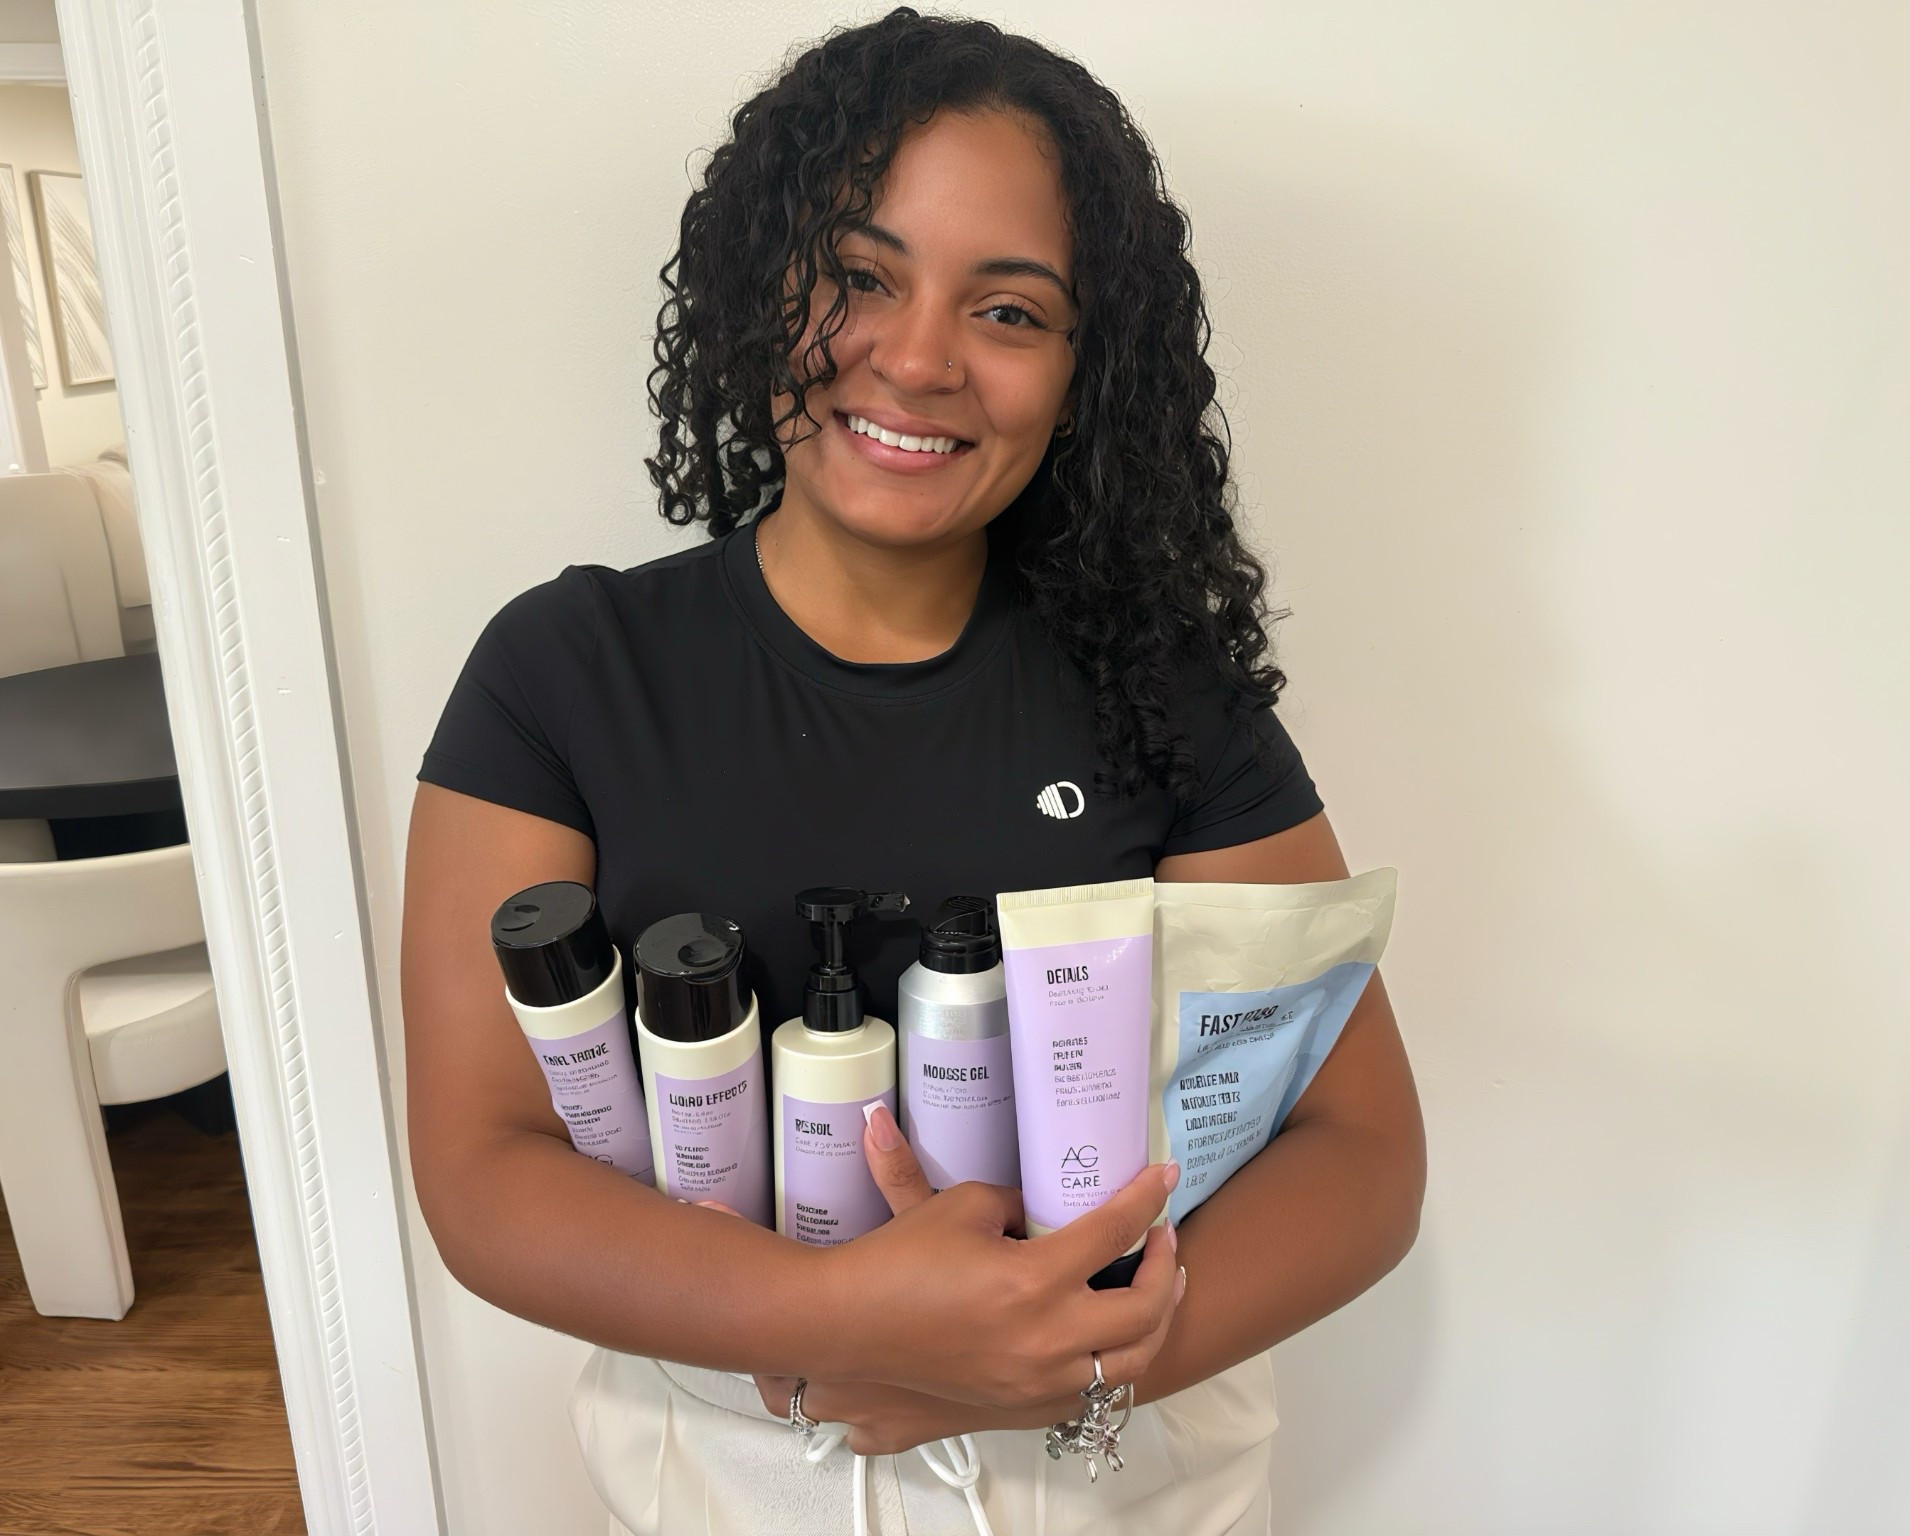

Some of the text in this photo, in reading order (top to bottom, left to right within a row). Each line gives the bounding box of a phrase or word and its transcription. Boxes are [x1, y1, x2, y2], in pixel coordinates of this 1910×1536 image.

[1200, 1013, 1243, 1037] FAST
[1061, 1145, 1099, 1168] AG
[1061, 1175, 1101, 1189] CARE
